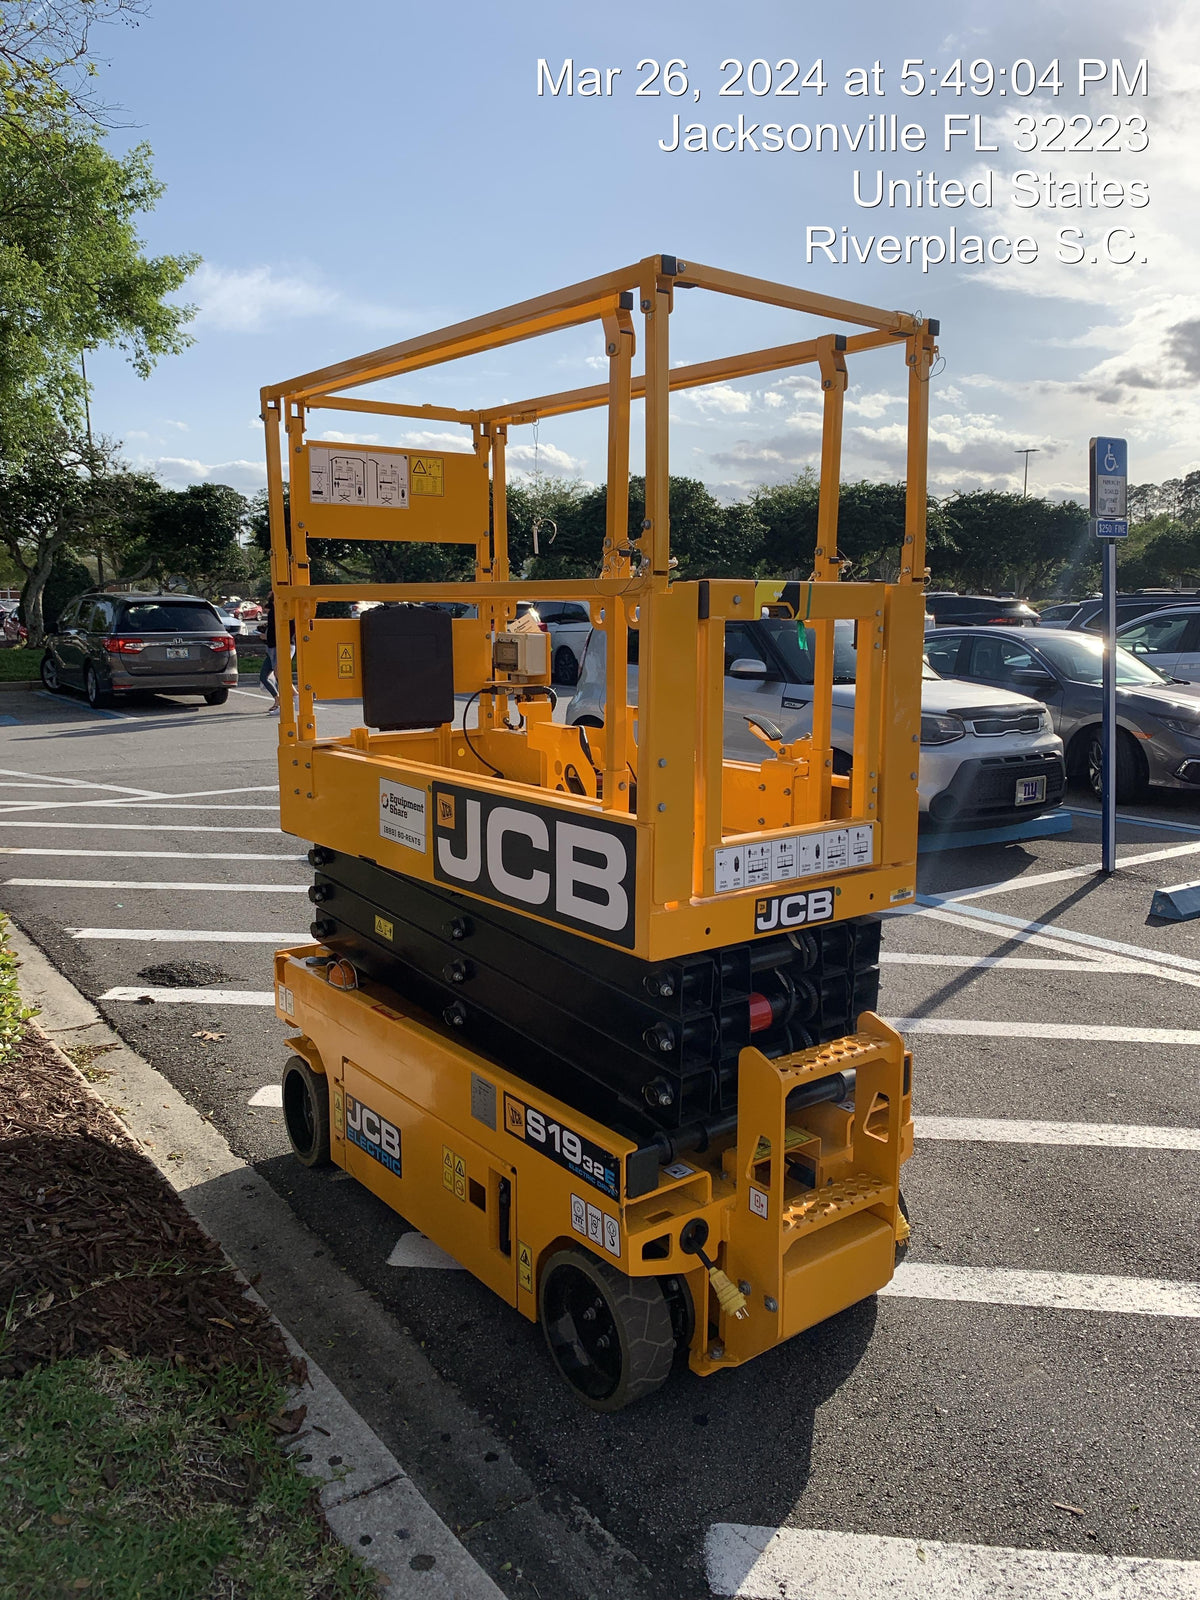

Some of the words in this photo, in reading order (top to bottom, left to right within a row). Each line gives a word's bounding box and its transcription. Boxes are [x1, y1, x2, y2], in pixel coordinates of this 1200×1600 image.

[389, 793, 424, 813] Equipment
[389, 804, 408, 819] Share
[437, 799, 628, 931] JCB
[756, 890, 833, 931] JCB
[347, 1101, 400, 1159] JCB
[347, 1125, 401, 1175] ELECTRIC
[568, 1162, 596, 1184] ELECTRIC
